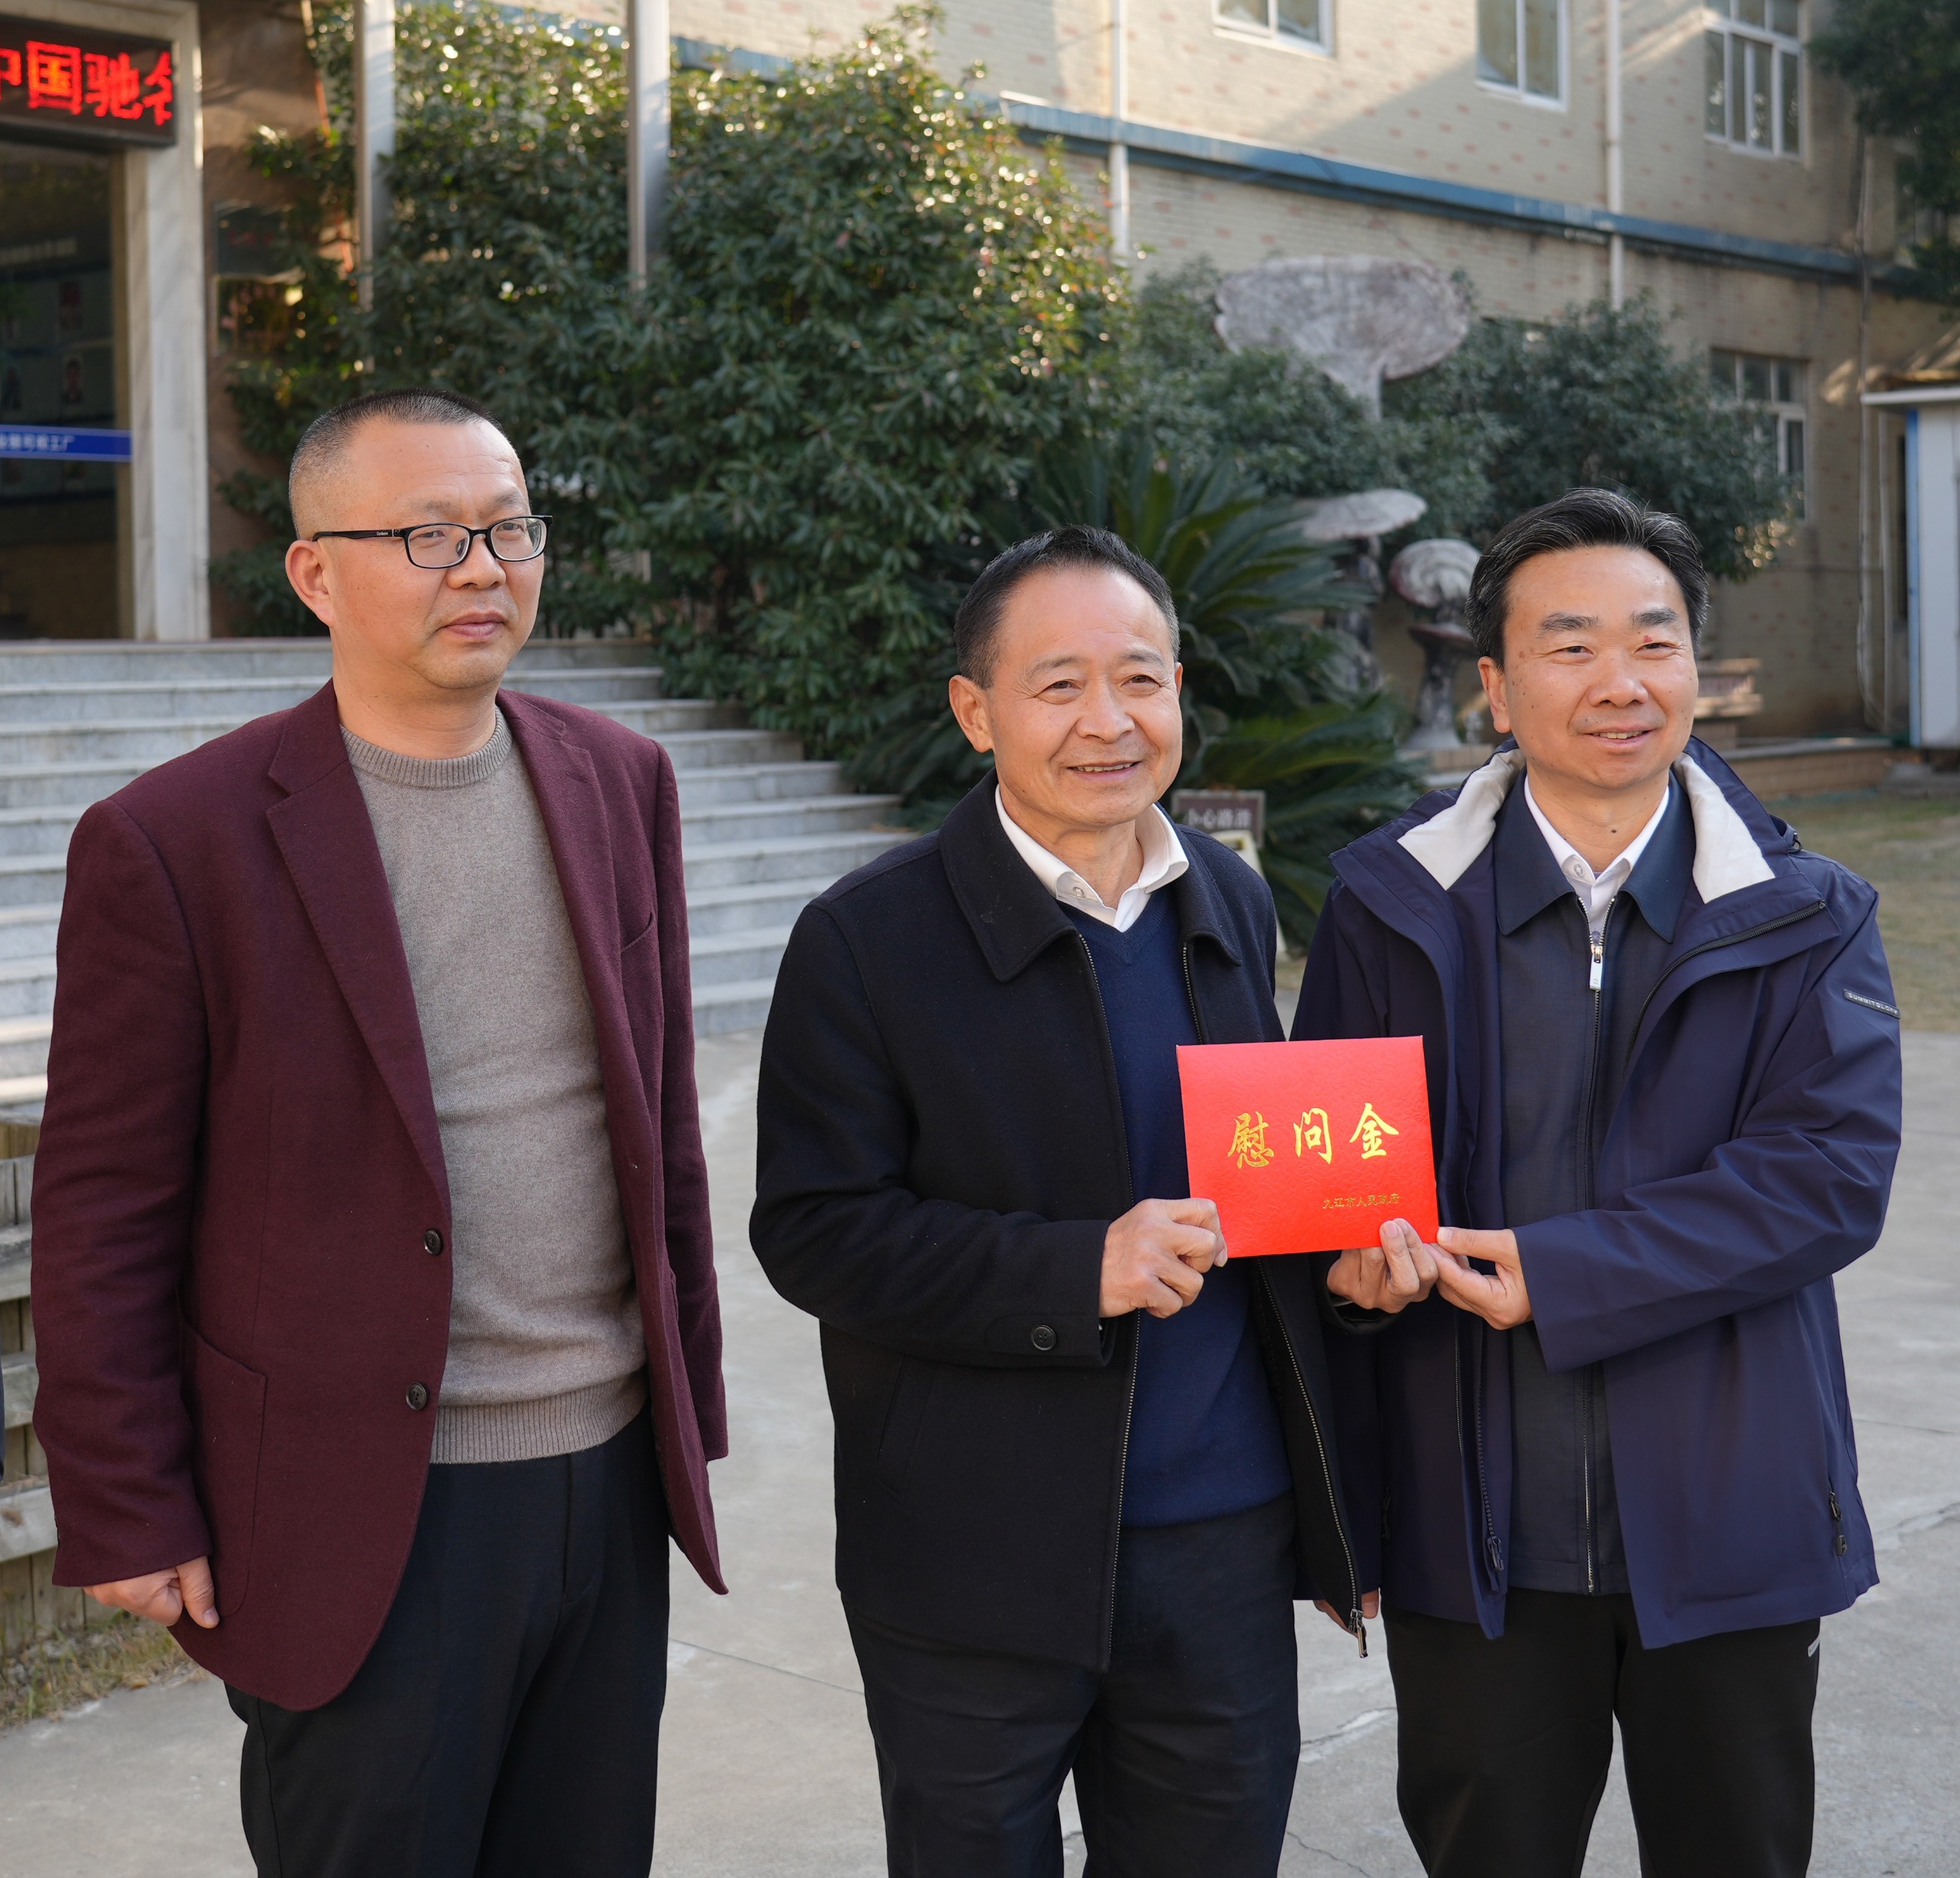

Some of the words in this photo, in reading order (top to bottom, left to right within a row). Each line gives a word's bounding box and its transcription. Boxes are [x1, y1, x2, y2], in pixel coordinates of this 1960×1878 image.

[1227, 1102, 1399, 1169] 慰问金
[1322, 1193, 1400, 1209] 九江市人民政府
